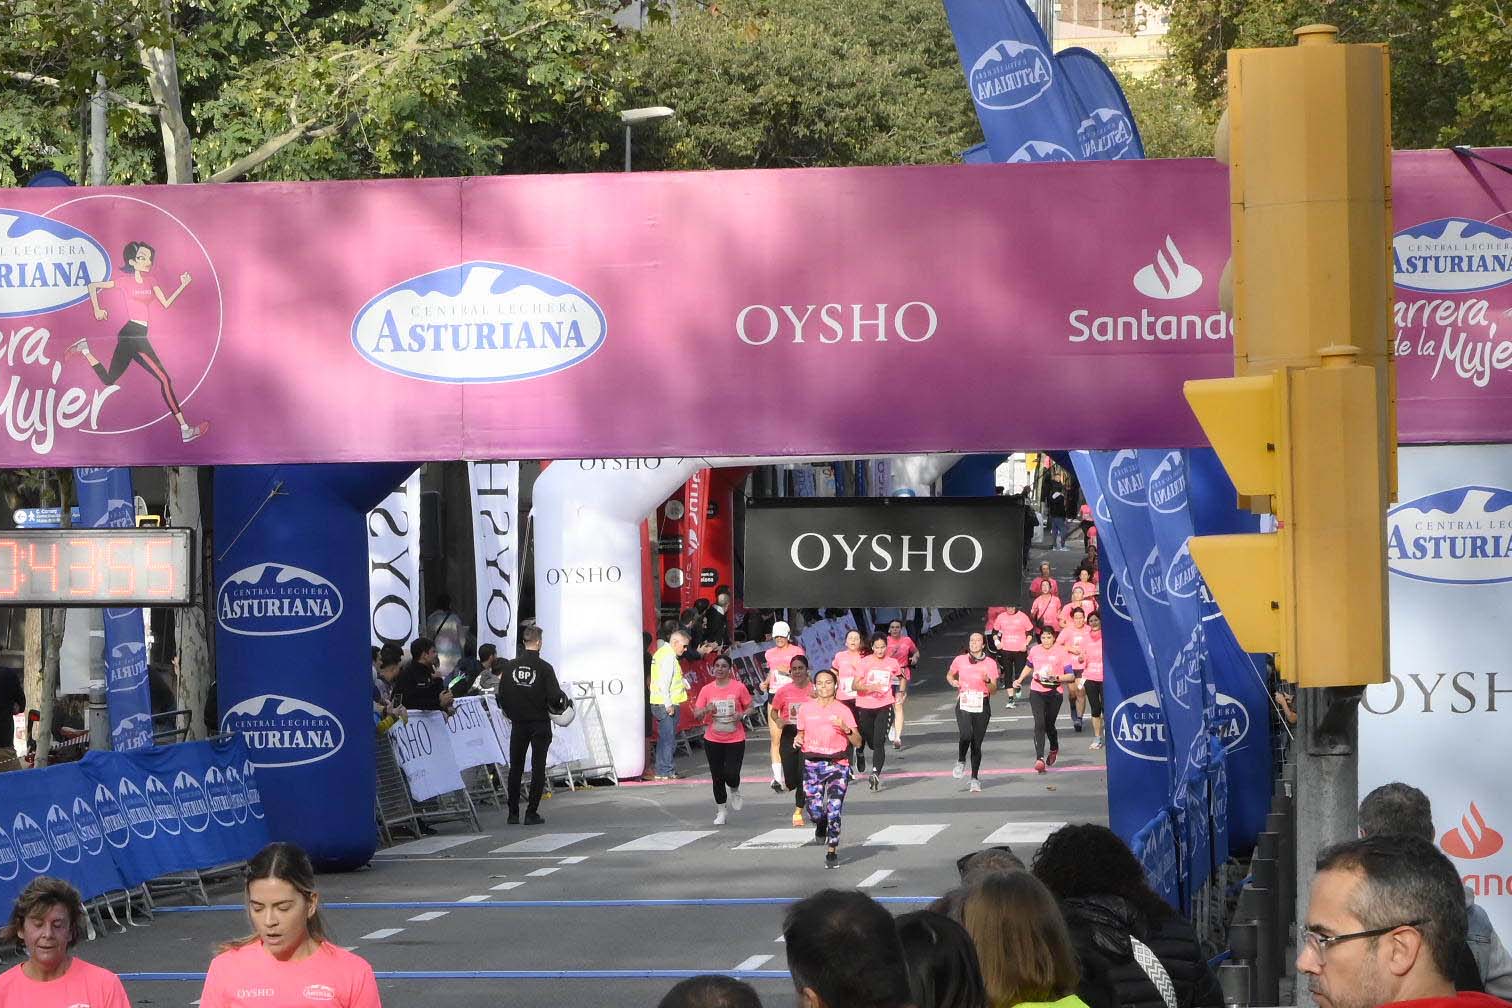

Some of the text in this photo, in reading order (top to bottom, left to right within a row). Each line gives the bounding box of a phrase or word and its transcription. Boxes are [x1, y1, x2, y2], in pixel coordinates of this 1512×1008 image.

[14, 245, 86, 257] LECHERA
[1407, 243, 1459, 252] CENTRAL
[410, 301, 580, 318] CENTRAL LECHERA
[1394, 298, 1490, 328] arrera
[371, 308, 587, 354] ASTURIANA
[734, 300, 939, 347] OYSHO
[1417, 322, 1512, 388] la Muje
[1415, 520, 1482, 531] CENTRAL
[790, 533, 984, 574] OYSHO
[545, 565, 622, 586] OYSHO
[233, 587, 329, 596] CENTRAL LECHERA
[221, 592, 334, 620] ASTURIANA
[518, 669, 531, 681] BP
[235, 719, 330, 728] CENTRAL LECHERA
